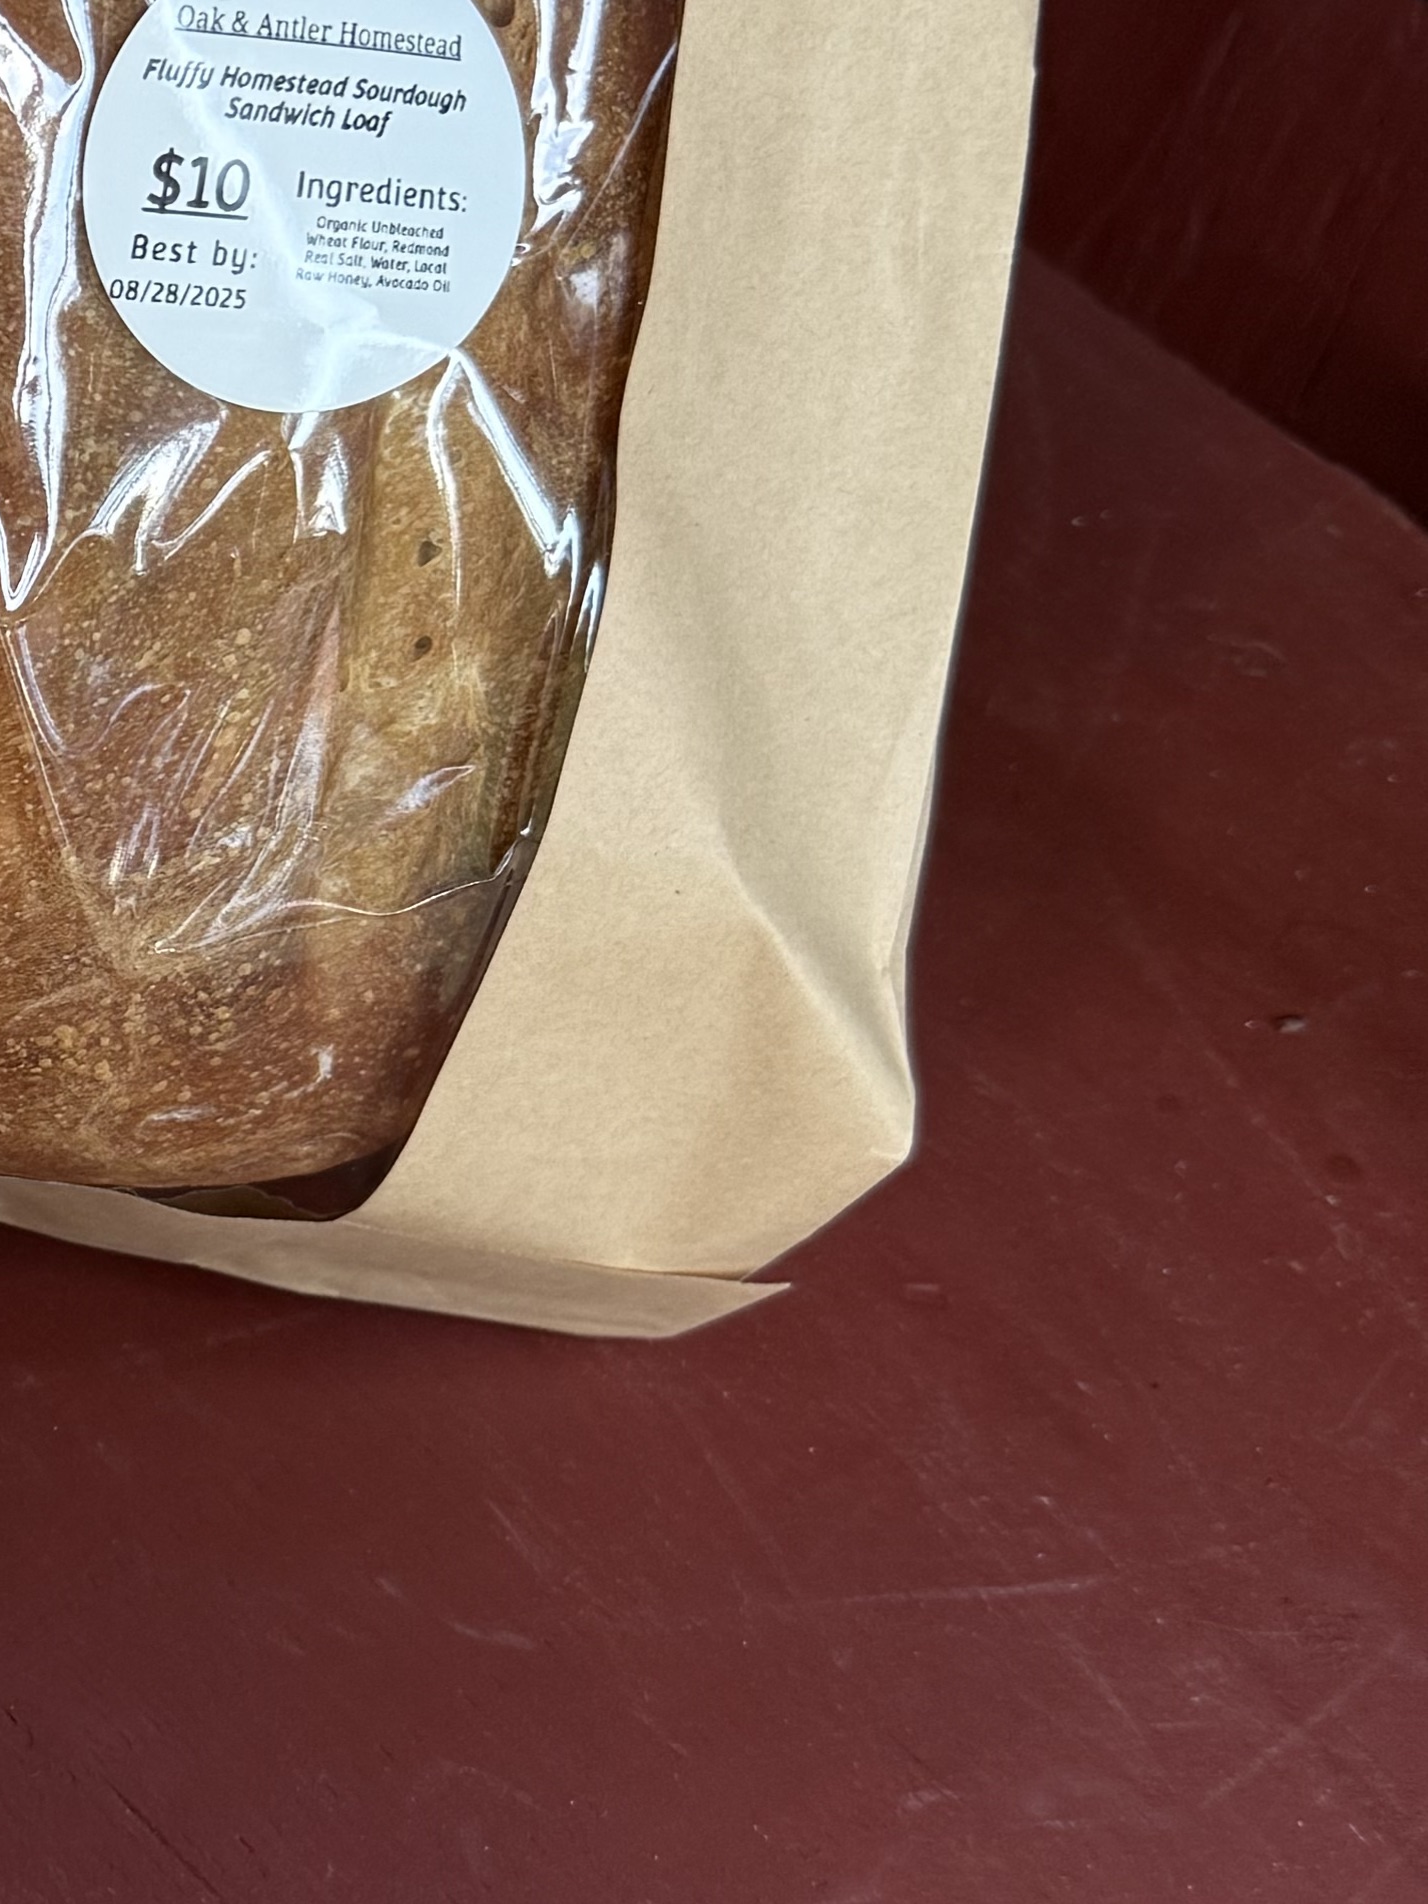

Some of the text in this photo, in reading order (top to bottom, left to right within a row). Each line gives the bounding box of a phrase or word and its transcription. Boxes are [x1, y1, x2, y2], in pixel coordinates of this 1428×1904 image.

[176, 5, 462, 60] Oak & Antler Homestead
[142, 58, 467, 113] Fluffy Homestead Sourdough
[225, 97, 393, 138] Sandwich Loaf
[146, 148, 251, 214] $10
[296, 171, 468, 214] Ingredients:
[306, 232, 449, 257] Wheat Flour, Redmond
[316, 215, 444, 239] Organic Unbleached
[130, 233, 259, 274] Best by:
[304, 249, 334, 265] Real
[371, 256, 410, 273] Water,
[414, 260, 447, 274] Local
[108, 278, 247, 310] 08/28/2025
[295, 267, 324, 281] Raw
[376, 275, 429, 291] Avocado
[433, 279, 451, 292] Oil
